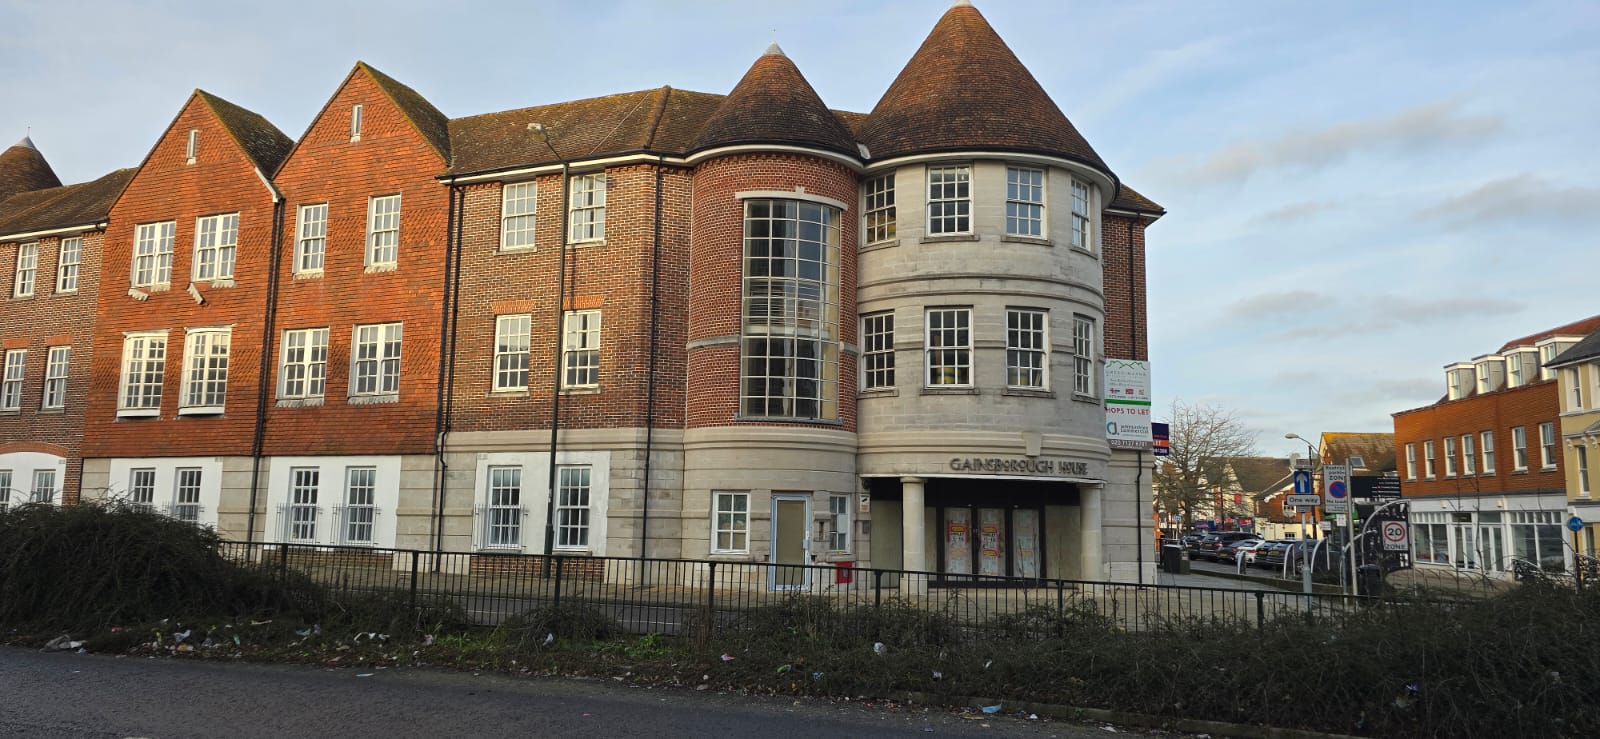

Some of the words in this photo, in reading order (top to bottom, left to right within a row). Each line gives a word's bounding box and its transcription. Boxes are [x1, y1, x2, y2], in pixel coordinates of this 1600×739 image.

[949, 458, 1053, 473] GAINSBOROUGH
[1058, 460, 1088, 475] HOUSE
[1387, 527, 1402, 536] 20
